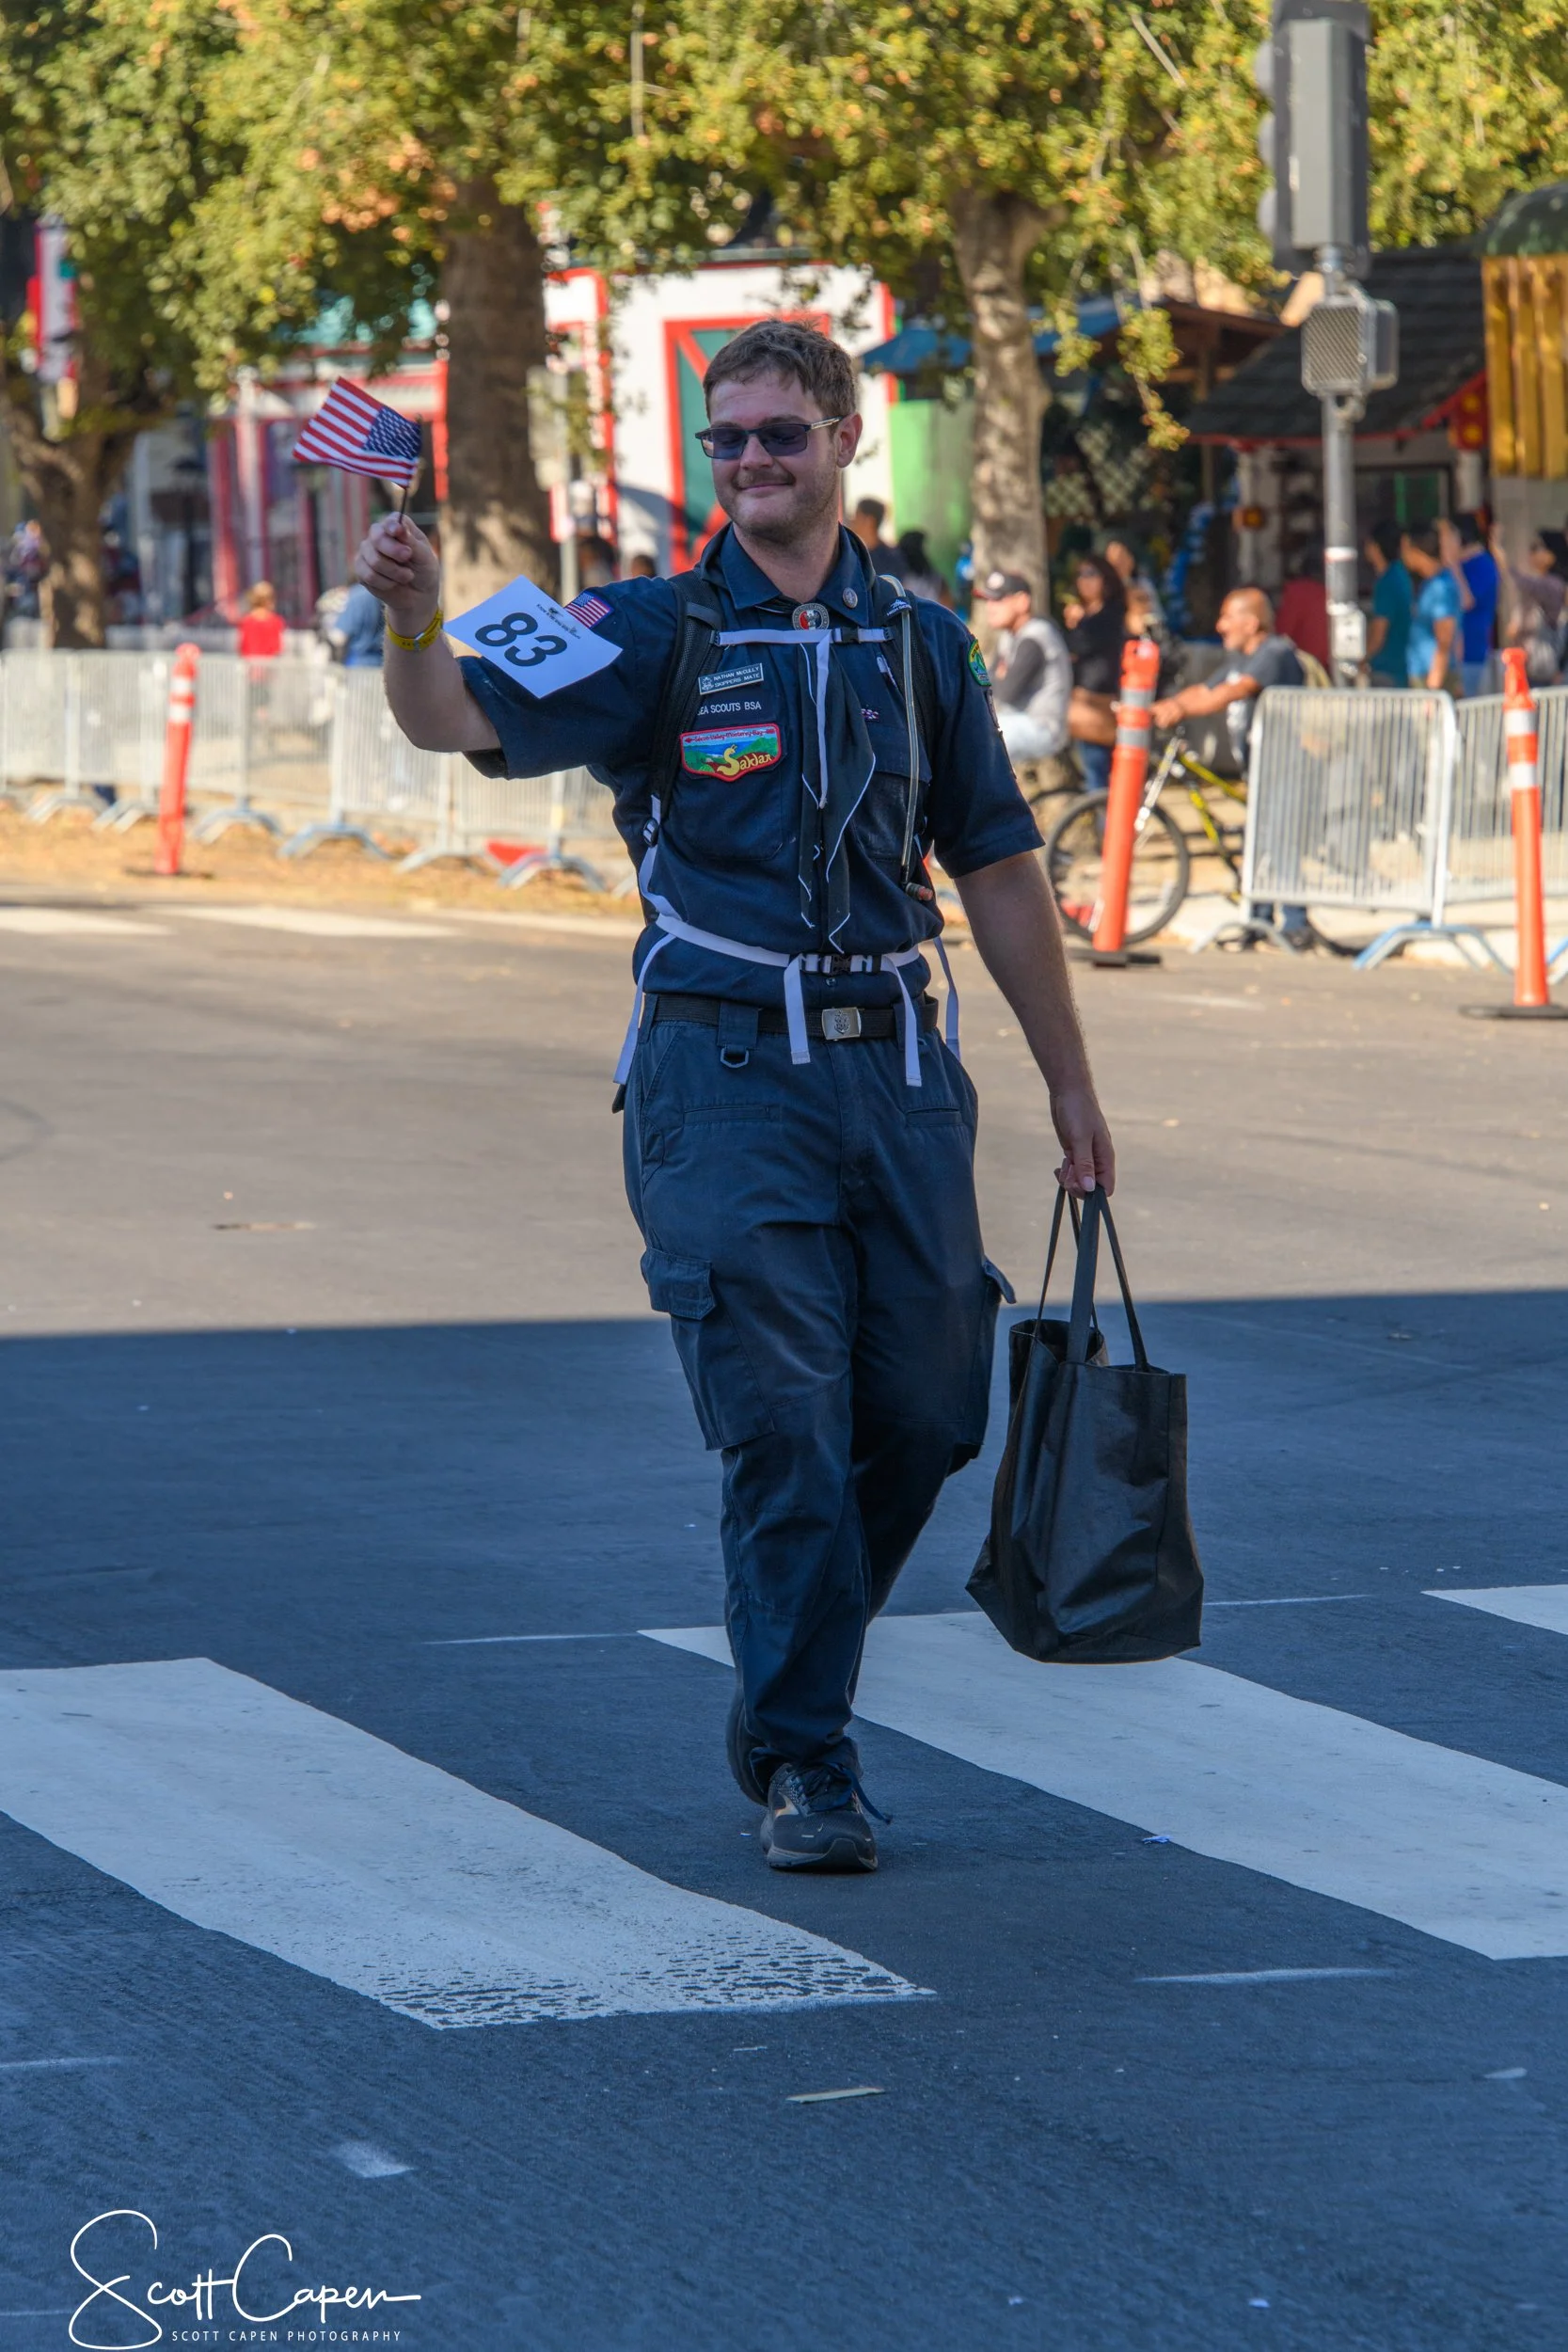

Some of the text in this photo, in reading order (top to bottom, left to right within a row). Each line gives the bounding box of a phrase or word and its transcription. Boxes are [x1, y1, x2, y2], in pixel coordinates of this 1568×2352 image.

[474, 612, 568, 667] 83
[713, 672, 735, 681] NATHAN
[744, 673, 760, 681] MATE
[698, 701, 762, 716] EA SCOUTS BSA
